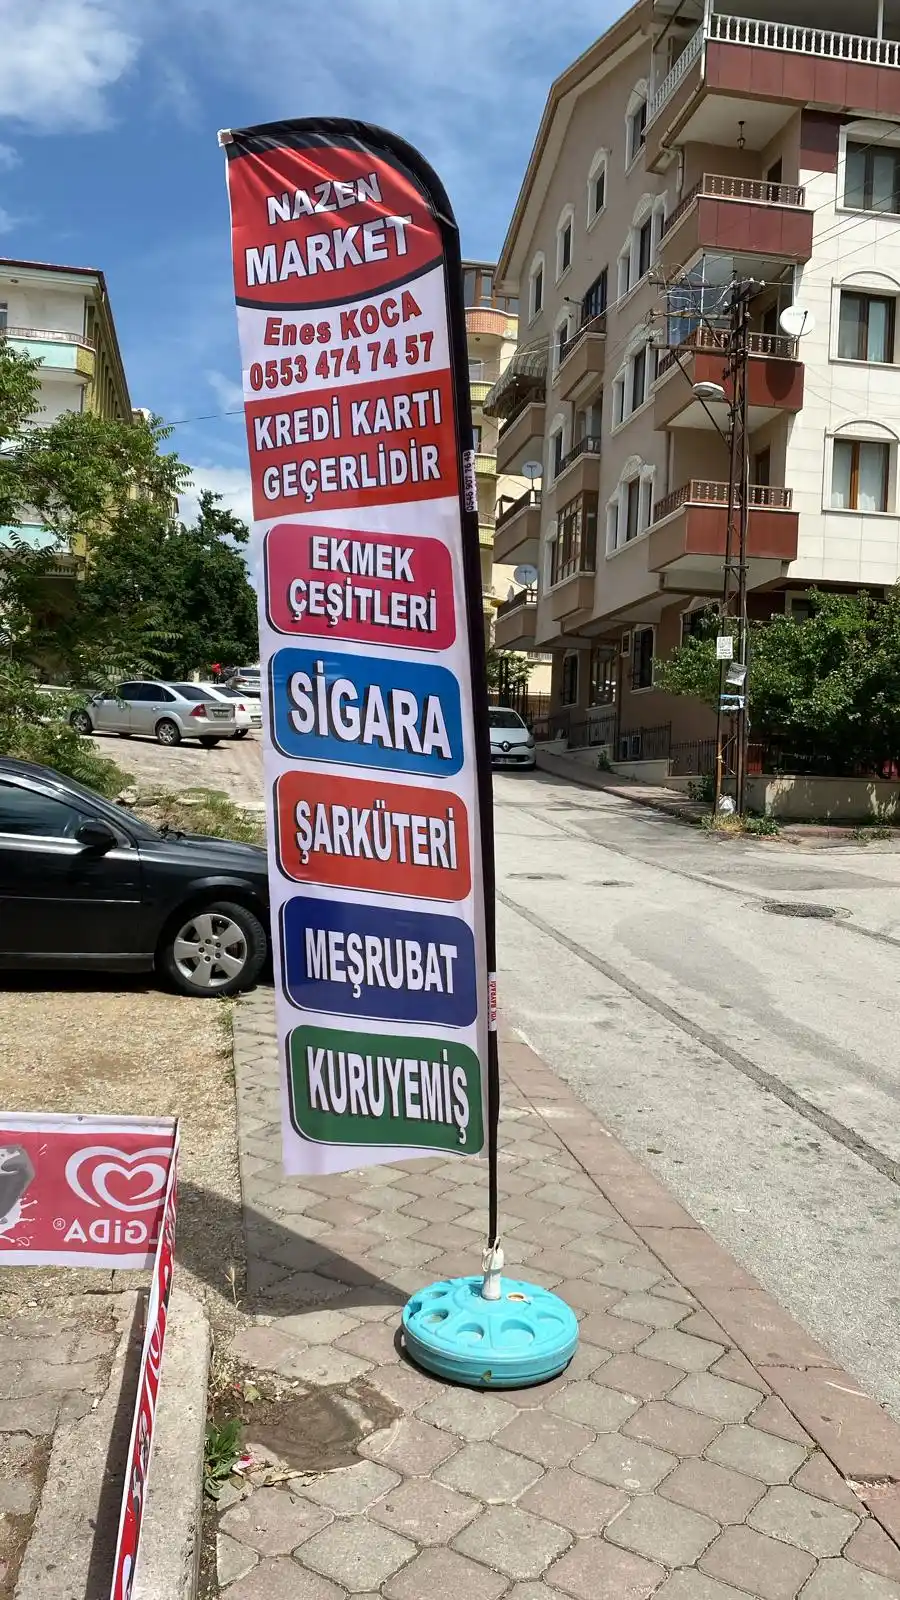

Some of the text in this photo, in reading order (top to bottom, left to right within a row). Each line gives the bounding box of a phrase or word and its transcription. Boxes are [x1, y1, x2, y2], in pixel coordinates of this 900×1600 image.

[266, 172, 382, 226] NAZEN
[244, 214, 413, 287] MARKET
[264, 290, 422, 346] Enes KOCA
[250, 332, 434, 391] 0553 474 74 57
[253, 389, 441, 451] KREDİ KARTI
[262, 438, 441, 502] GEÇERLİDİR
[310, 536, 414, 582] EKMEK
[289, 577, 437, 631] ÇEŞİTLERİ
[290, 660, 452, 759] SİGARA
[296, 800, 457, 869] ŞARKÜTERİ
[305, 928, 458, 998] MEŞRUBAT
[306, 1046, 469, 1145] KURUYEMİŞ
